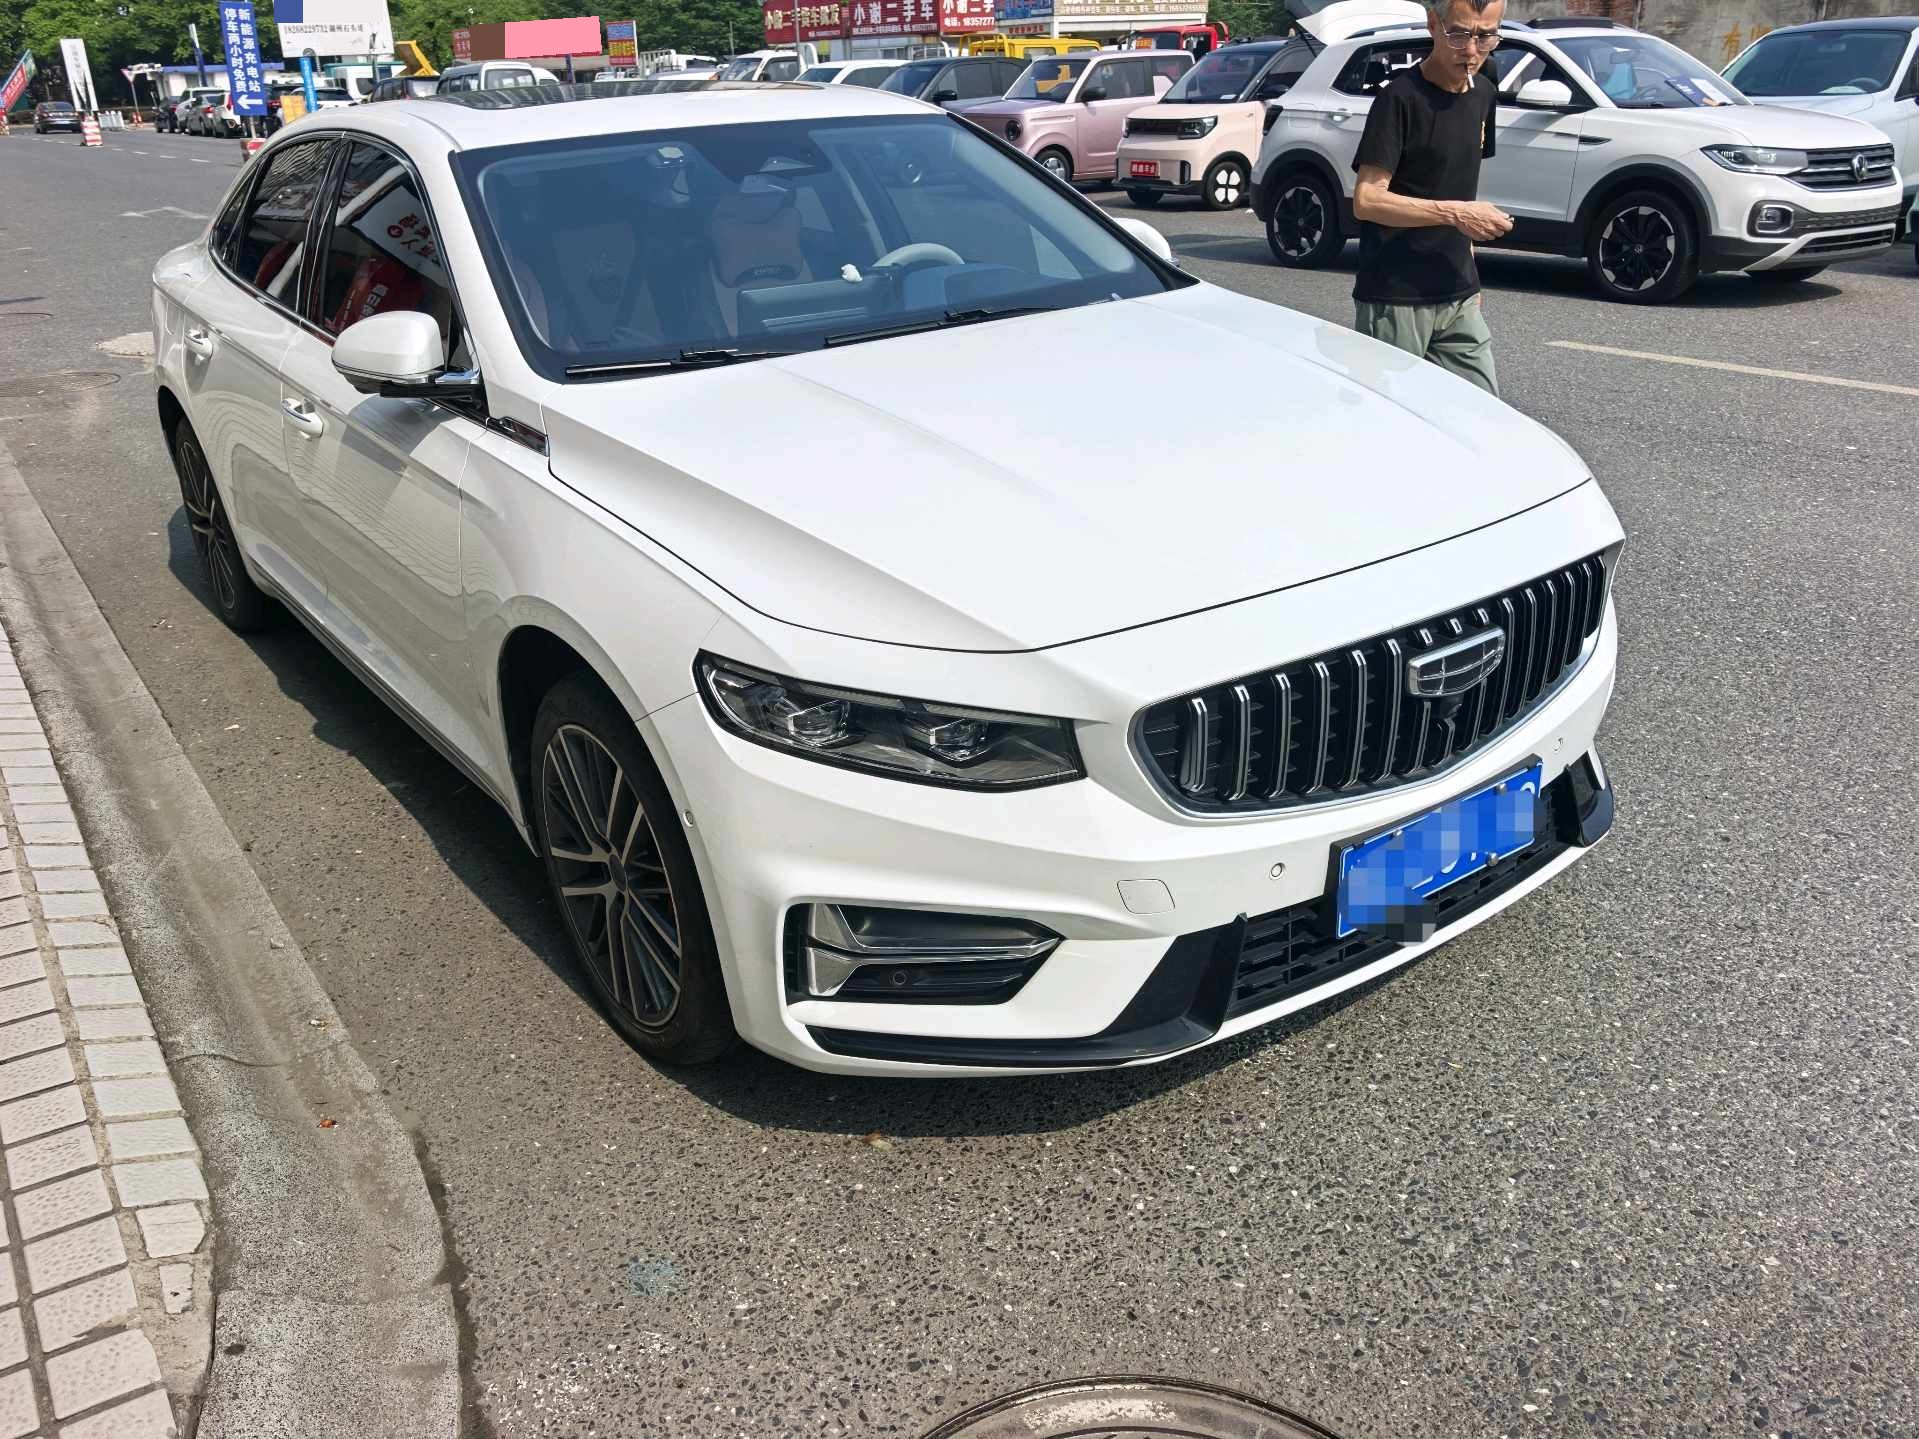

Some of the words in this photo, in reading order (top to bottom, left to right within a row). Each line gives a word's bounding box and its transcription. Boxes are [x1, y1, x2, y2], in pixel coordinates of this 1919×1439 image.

[224, 8, 248, 92] 停车两小时免费
[239, 8, 261, 92] 新能源充电站
